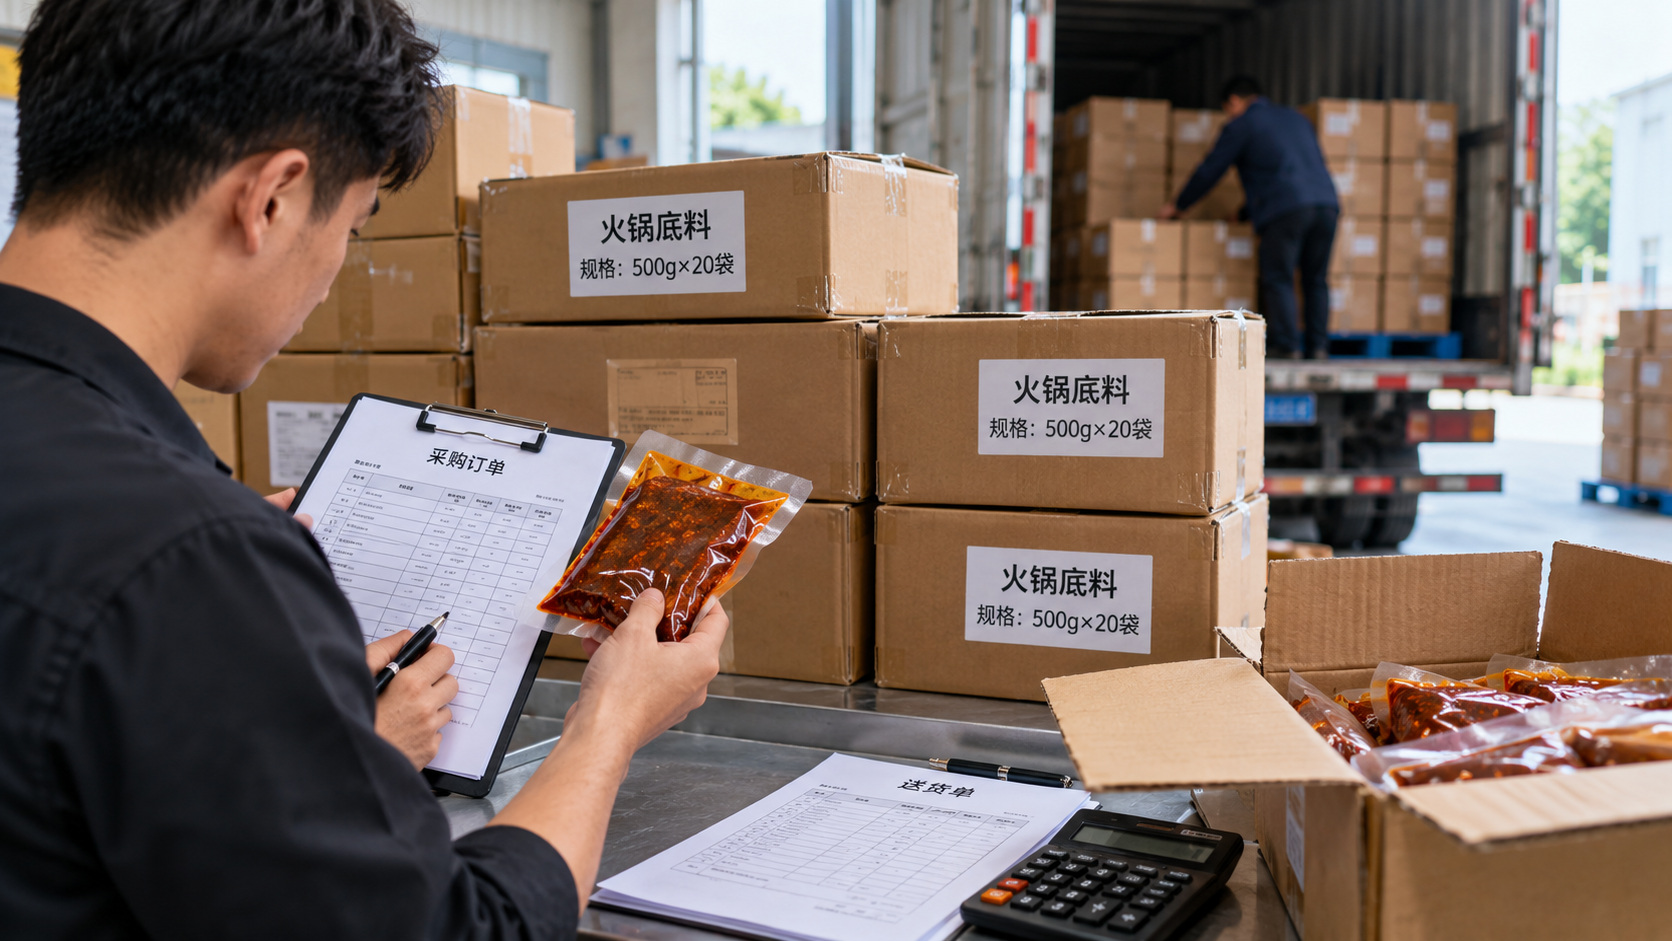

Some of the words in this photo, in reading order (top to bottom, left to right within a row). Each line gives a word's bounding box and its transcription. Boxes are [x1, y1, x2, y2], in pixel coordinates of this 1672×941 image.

[600, 208, 712, 245] 火锅底料
[1013, 374, 1130, 405] 火锅底料
[426, 447, 506, 476] 采购订单
[1001, 563, 1118, 600] 火锅底料
[897, 778, 976, 799] 送货单
